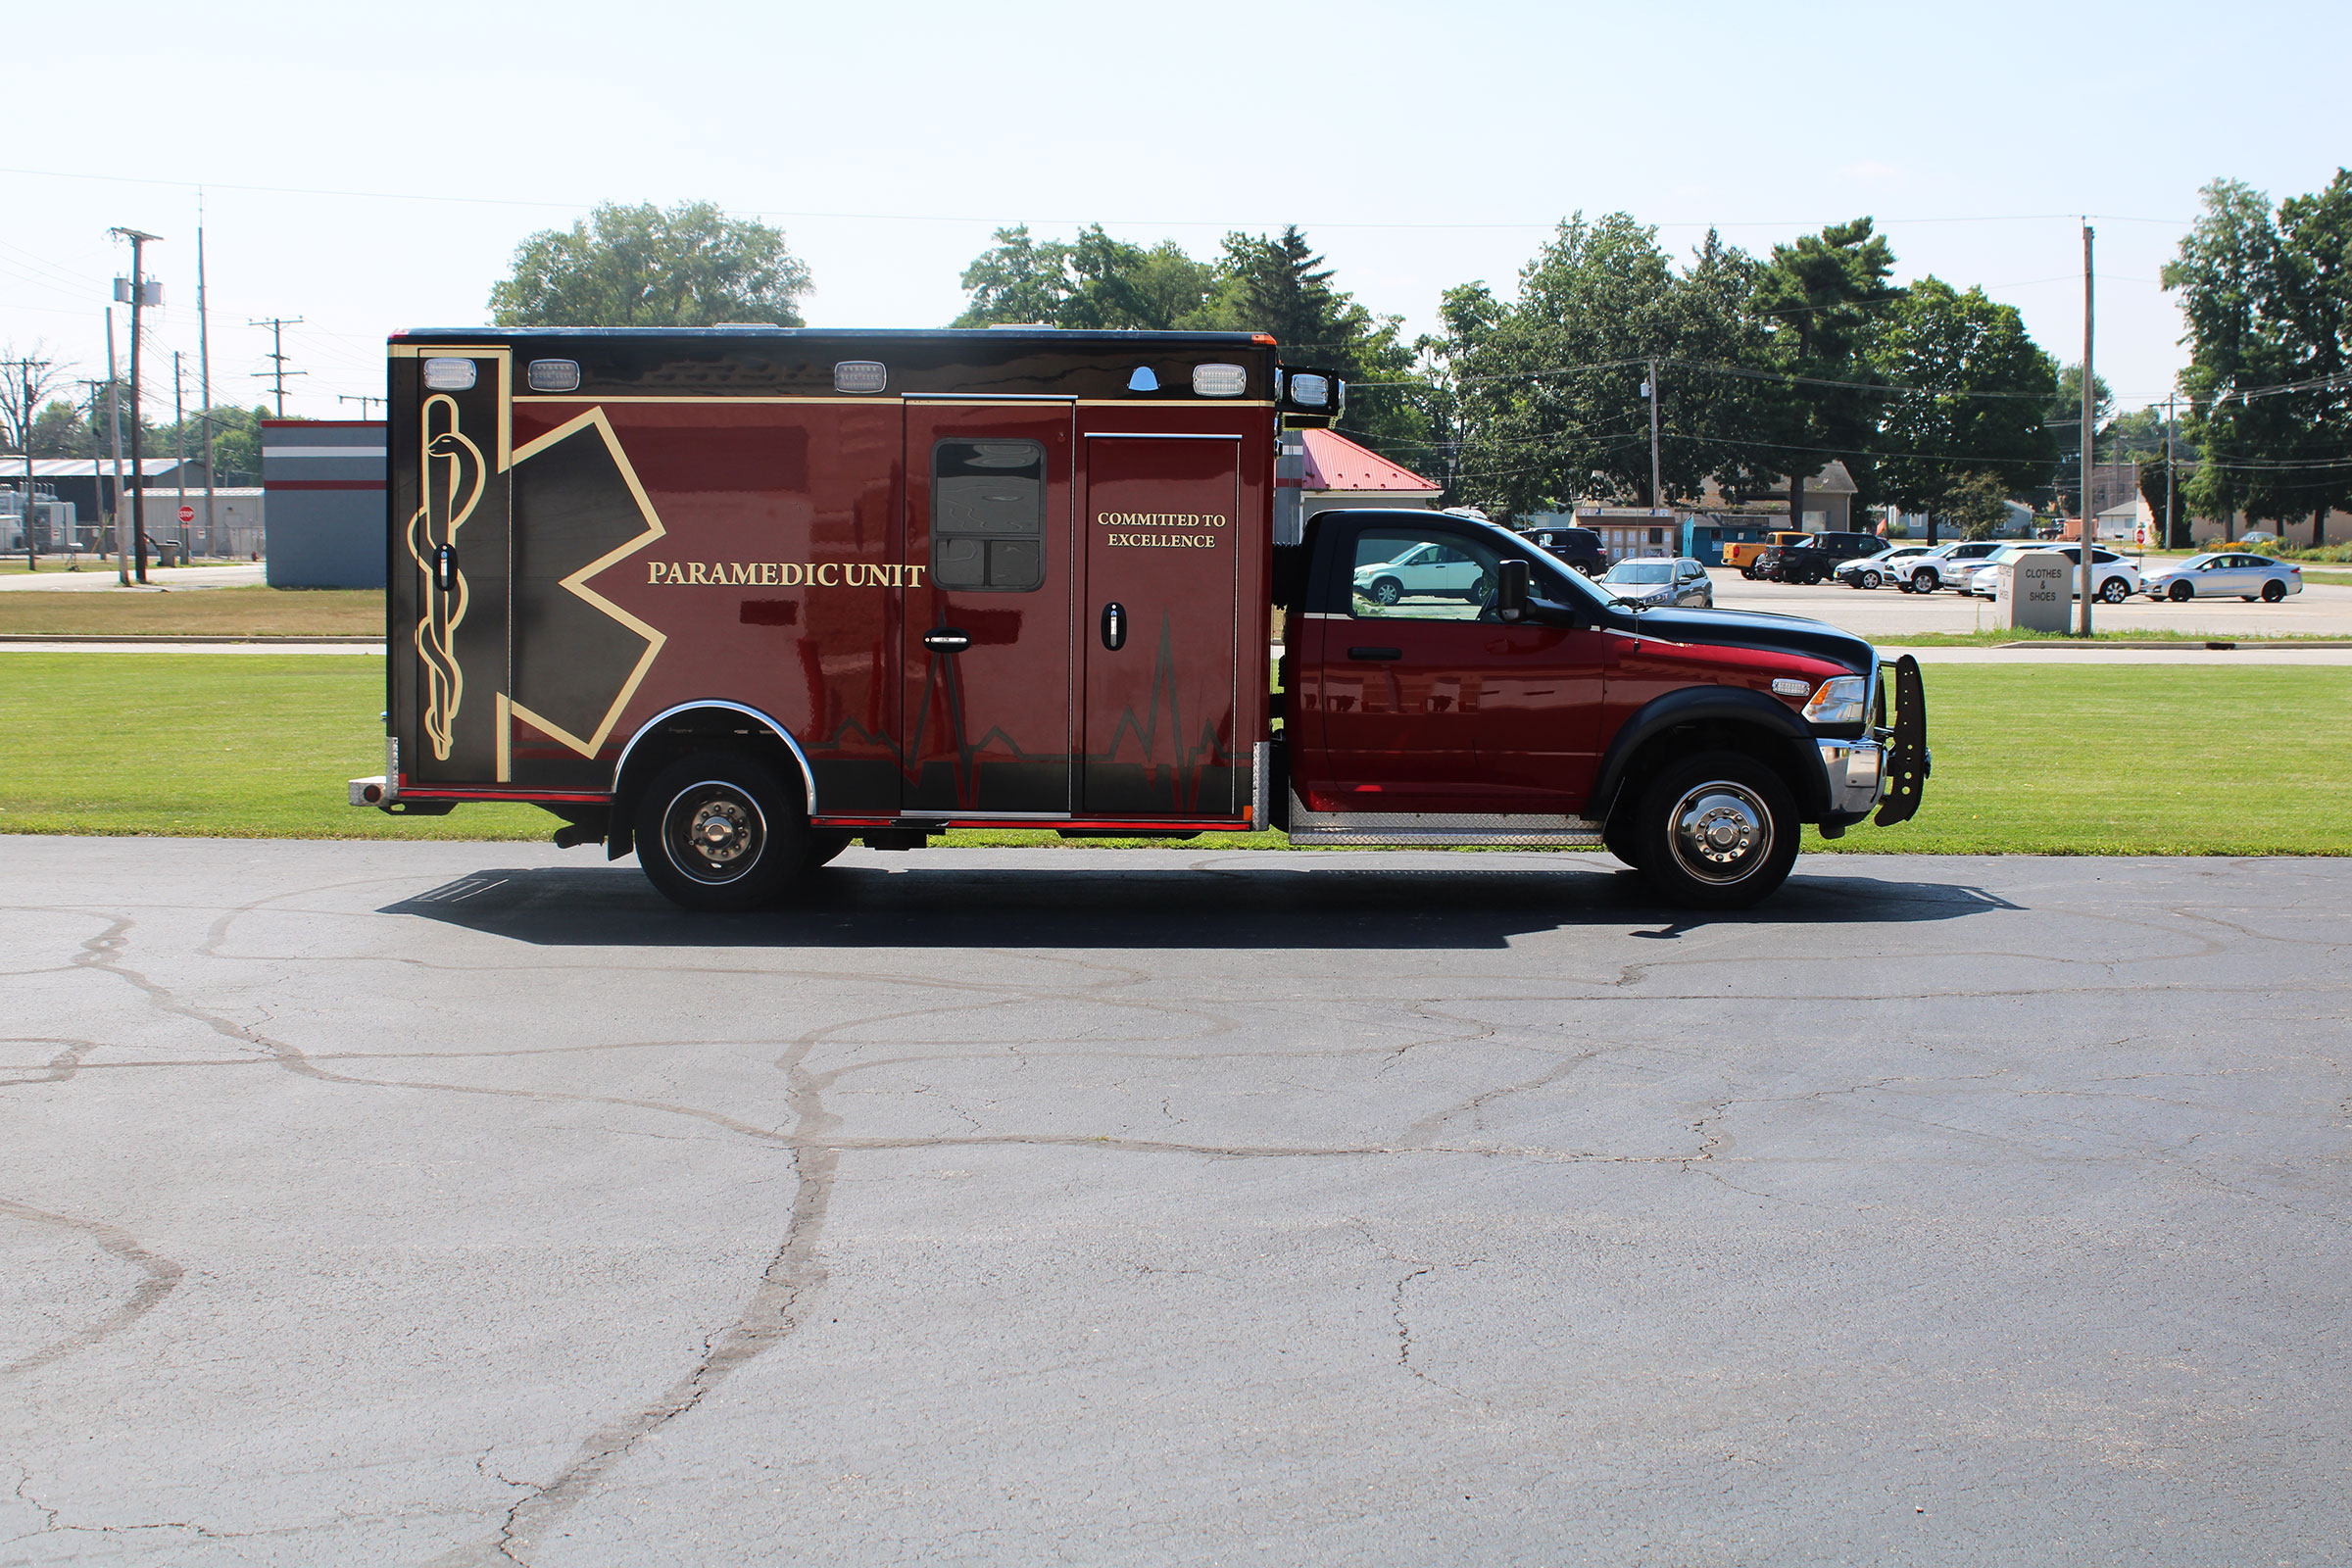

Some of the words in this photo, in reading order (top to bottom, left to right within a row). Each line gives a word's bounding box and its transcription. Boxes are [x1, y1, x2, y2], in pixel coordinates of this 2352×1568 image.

[1097, 513, 1200, 527] COMMITTED
[1202, 514, 1227, 527] TO
[1107, 533, 1216, 549] EXCELLENCE
[647, 562, 839, 586] PARAMEDIC
[843, 564, 926, 588] UNIT
[2025, 568, 2062, 578] CLOTHES
[2039, 580, 2046, 590] &
[2029, 591, 2057, 601] SHOES
